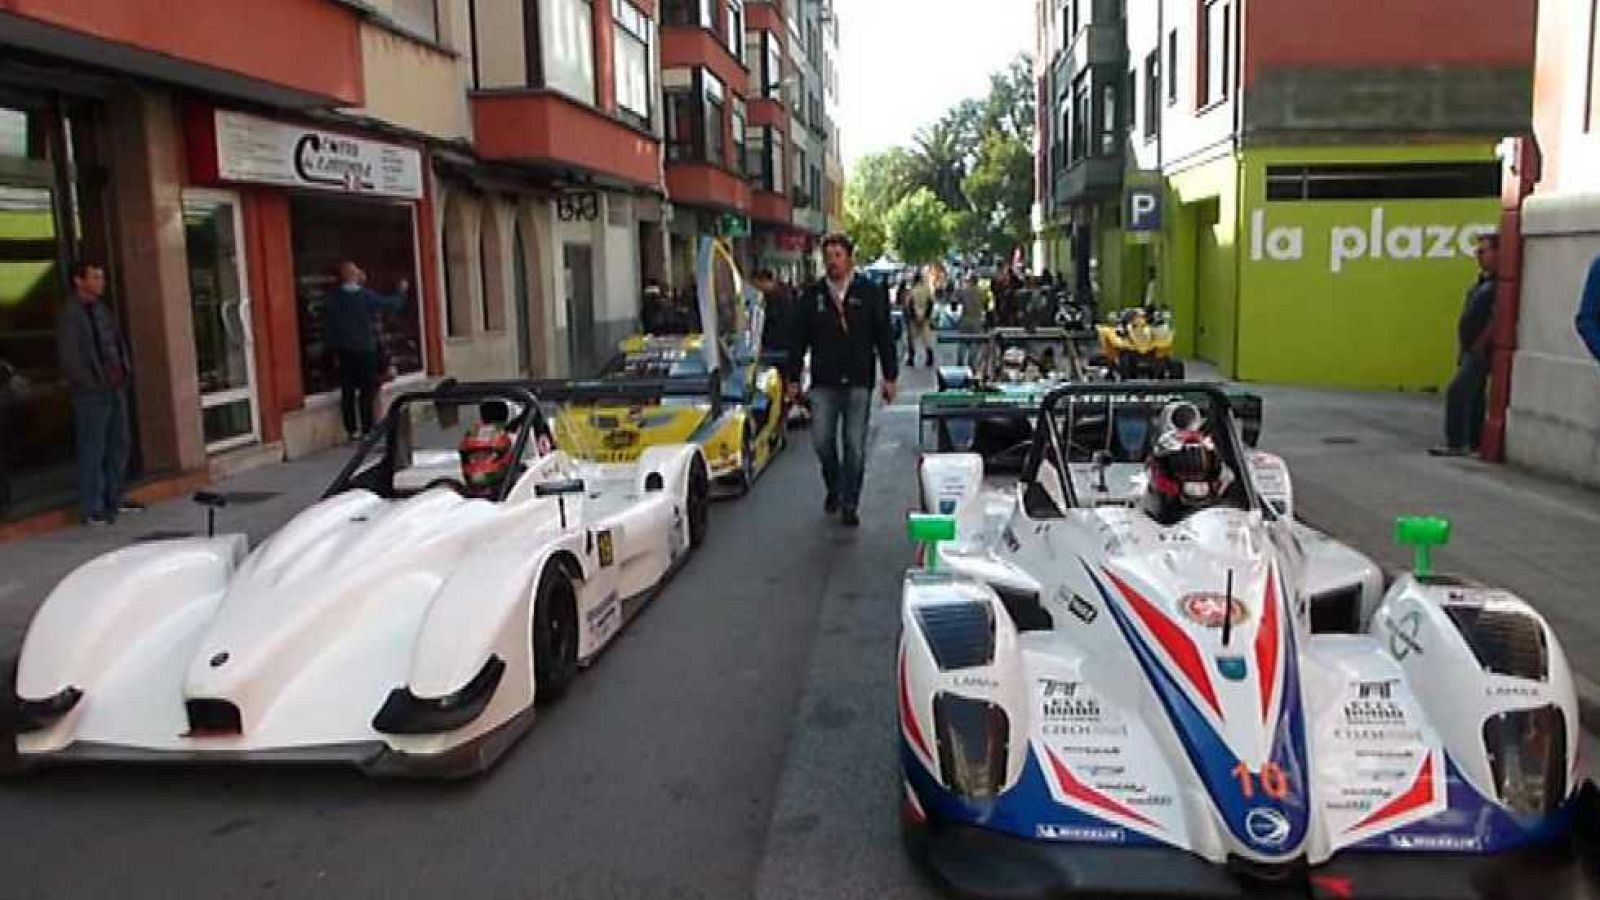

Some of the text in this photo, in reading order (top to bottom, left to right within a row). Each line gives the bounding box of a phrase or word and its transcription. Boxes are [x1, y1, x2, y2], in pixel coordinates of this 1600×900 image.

[1132, 194, 1155, 225] P
[1251, 208, 1303, 261] la
[1232, 762, 1289, 800] 10
